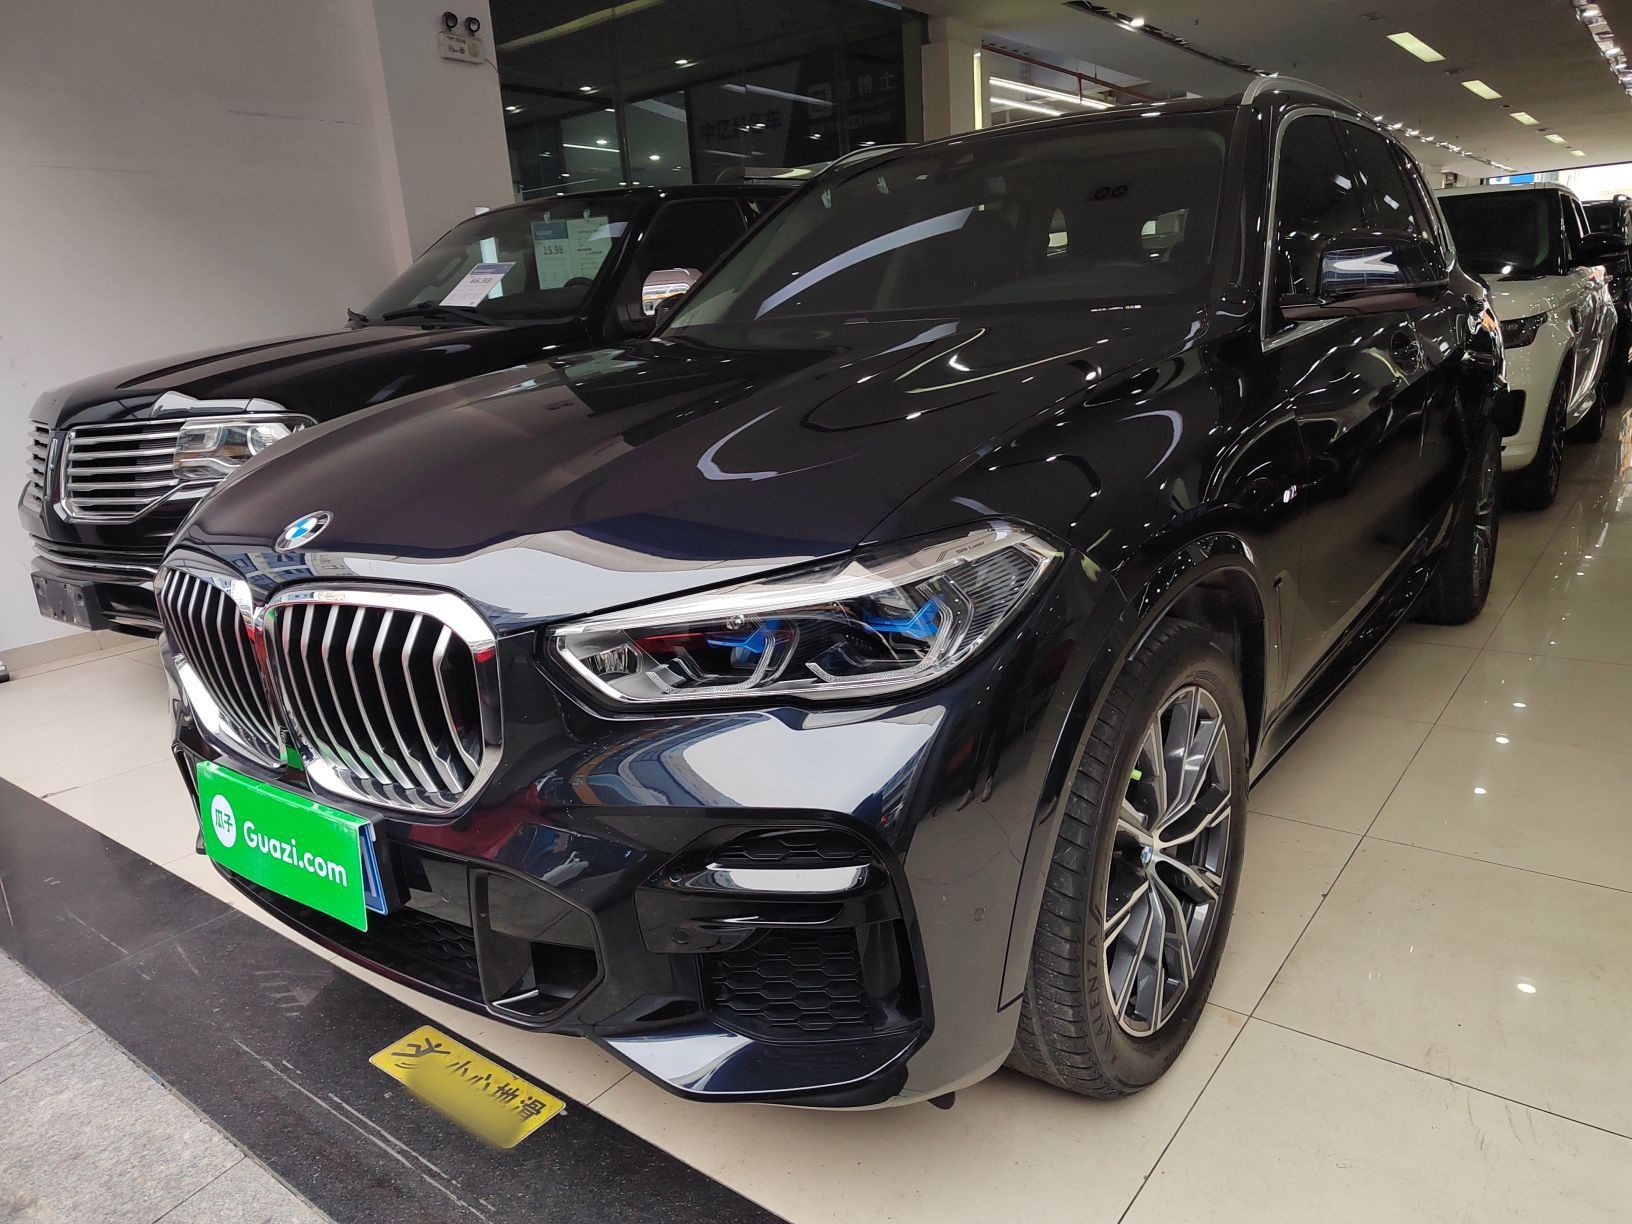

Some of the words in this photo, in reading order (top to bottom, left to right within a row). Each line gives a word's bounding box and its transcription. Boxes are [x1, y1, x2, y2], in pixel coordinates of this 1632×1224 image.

[543, 244, 564, 256] 15.98
[215, 808, 233, 833] 瓜子
[243, 820, 348, 888] Guazi.com
[1087, 932, 1106, 1037] ALENZA
